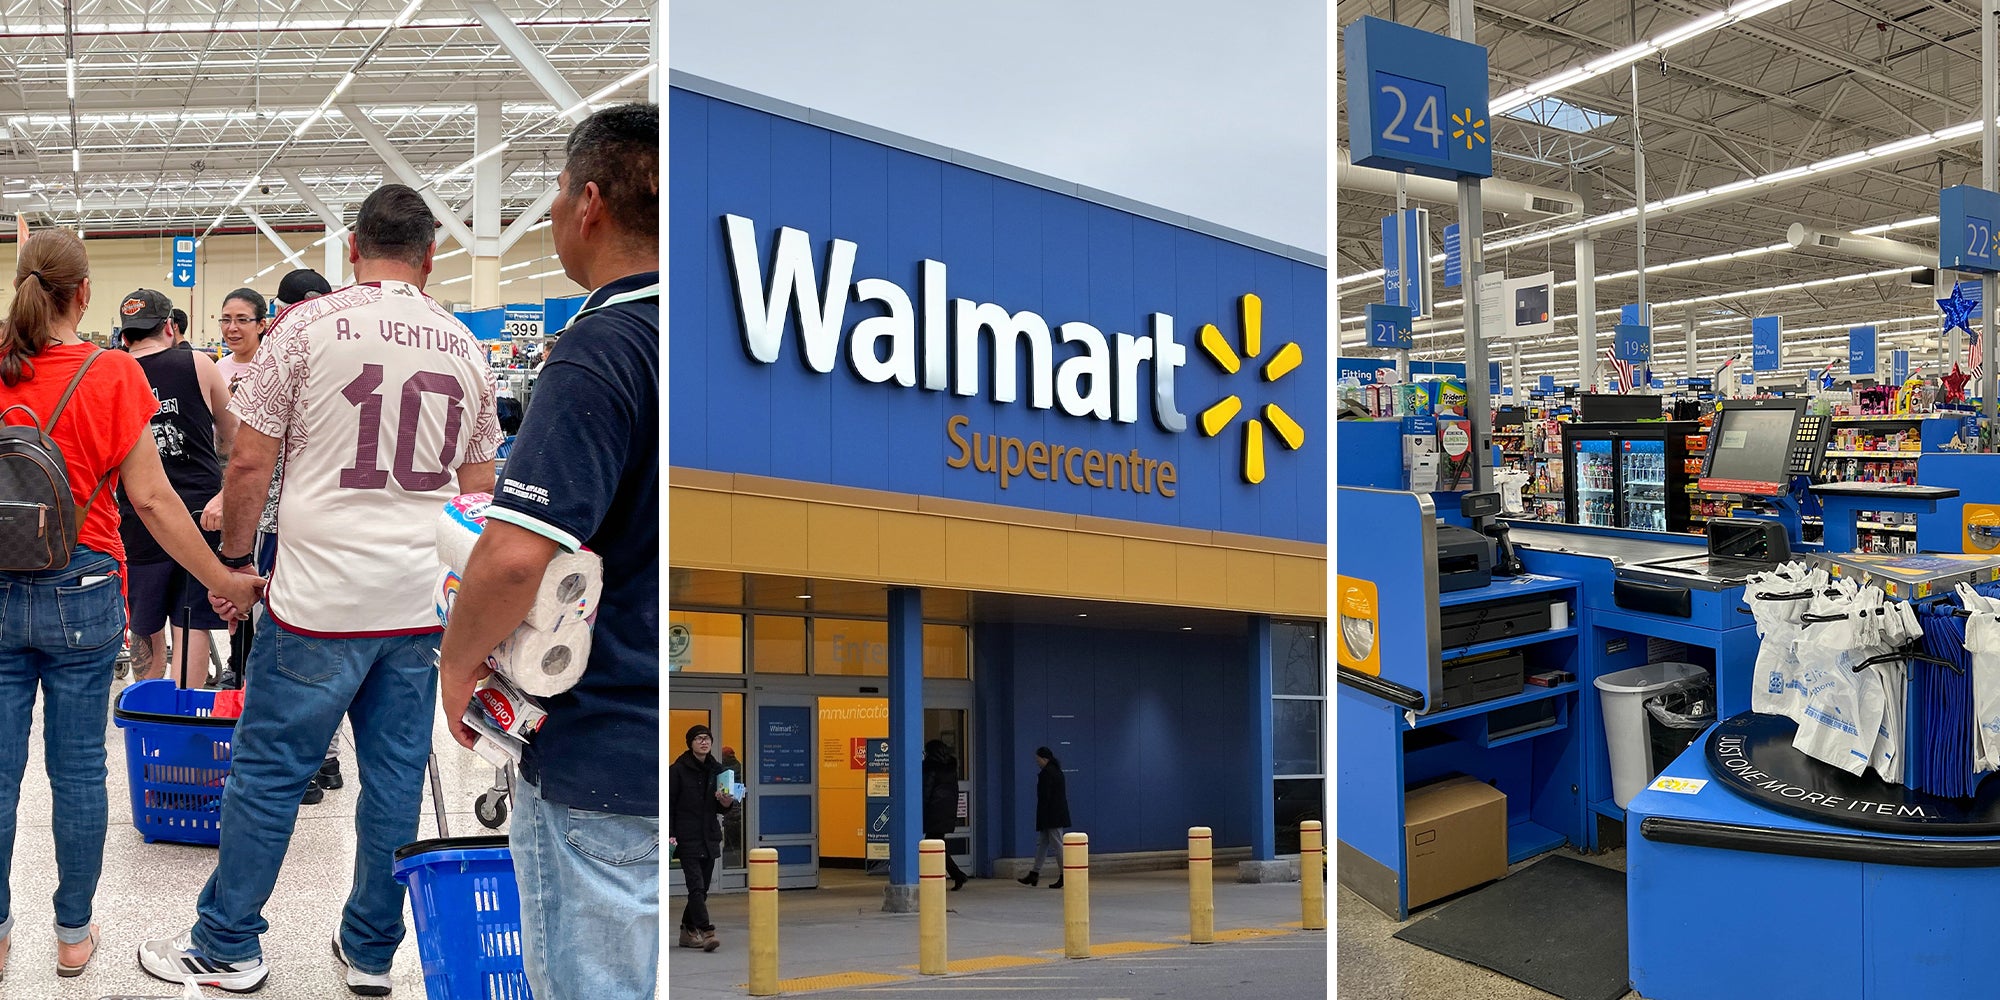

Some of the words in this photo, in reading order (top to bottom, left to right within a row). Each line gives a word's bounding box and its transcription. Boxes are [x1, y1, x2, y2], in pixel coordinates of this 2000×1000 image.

[1381, 85, 1444, 149] 24
[1967, 222, 1990, 260] 22
[719, 213, 1187, 433] Walmart
[1377, 323, 1396, 342] 21
[336, 317, 361, 341] A.
[379, 319, 471, 360] VENTURA
[1625, 340, 1639, 356] 19
[1341, 369, 1372, 380] Fitting
[1442, 393, 1466, 401] Trident
[339, 363, 465, 492] 10
[946, 414, 1177, 497] Supercentre
[484, 691, 512, 725] Colgate
[1718, 736, 1743, 758] JUST
[1725, 759, 1768, 782] ONE
[1757, 780, 1844, 808] MORE
[1848, 800, 1925, 817] ITEM
